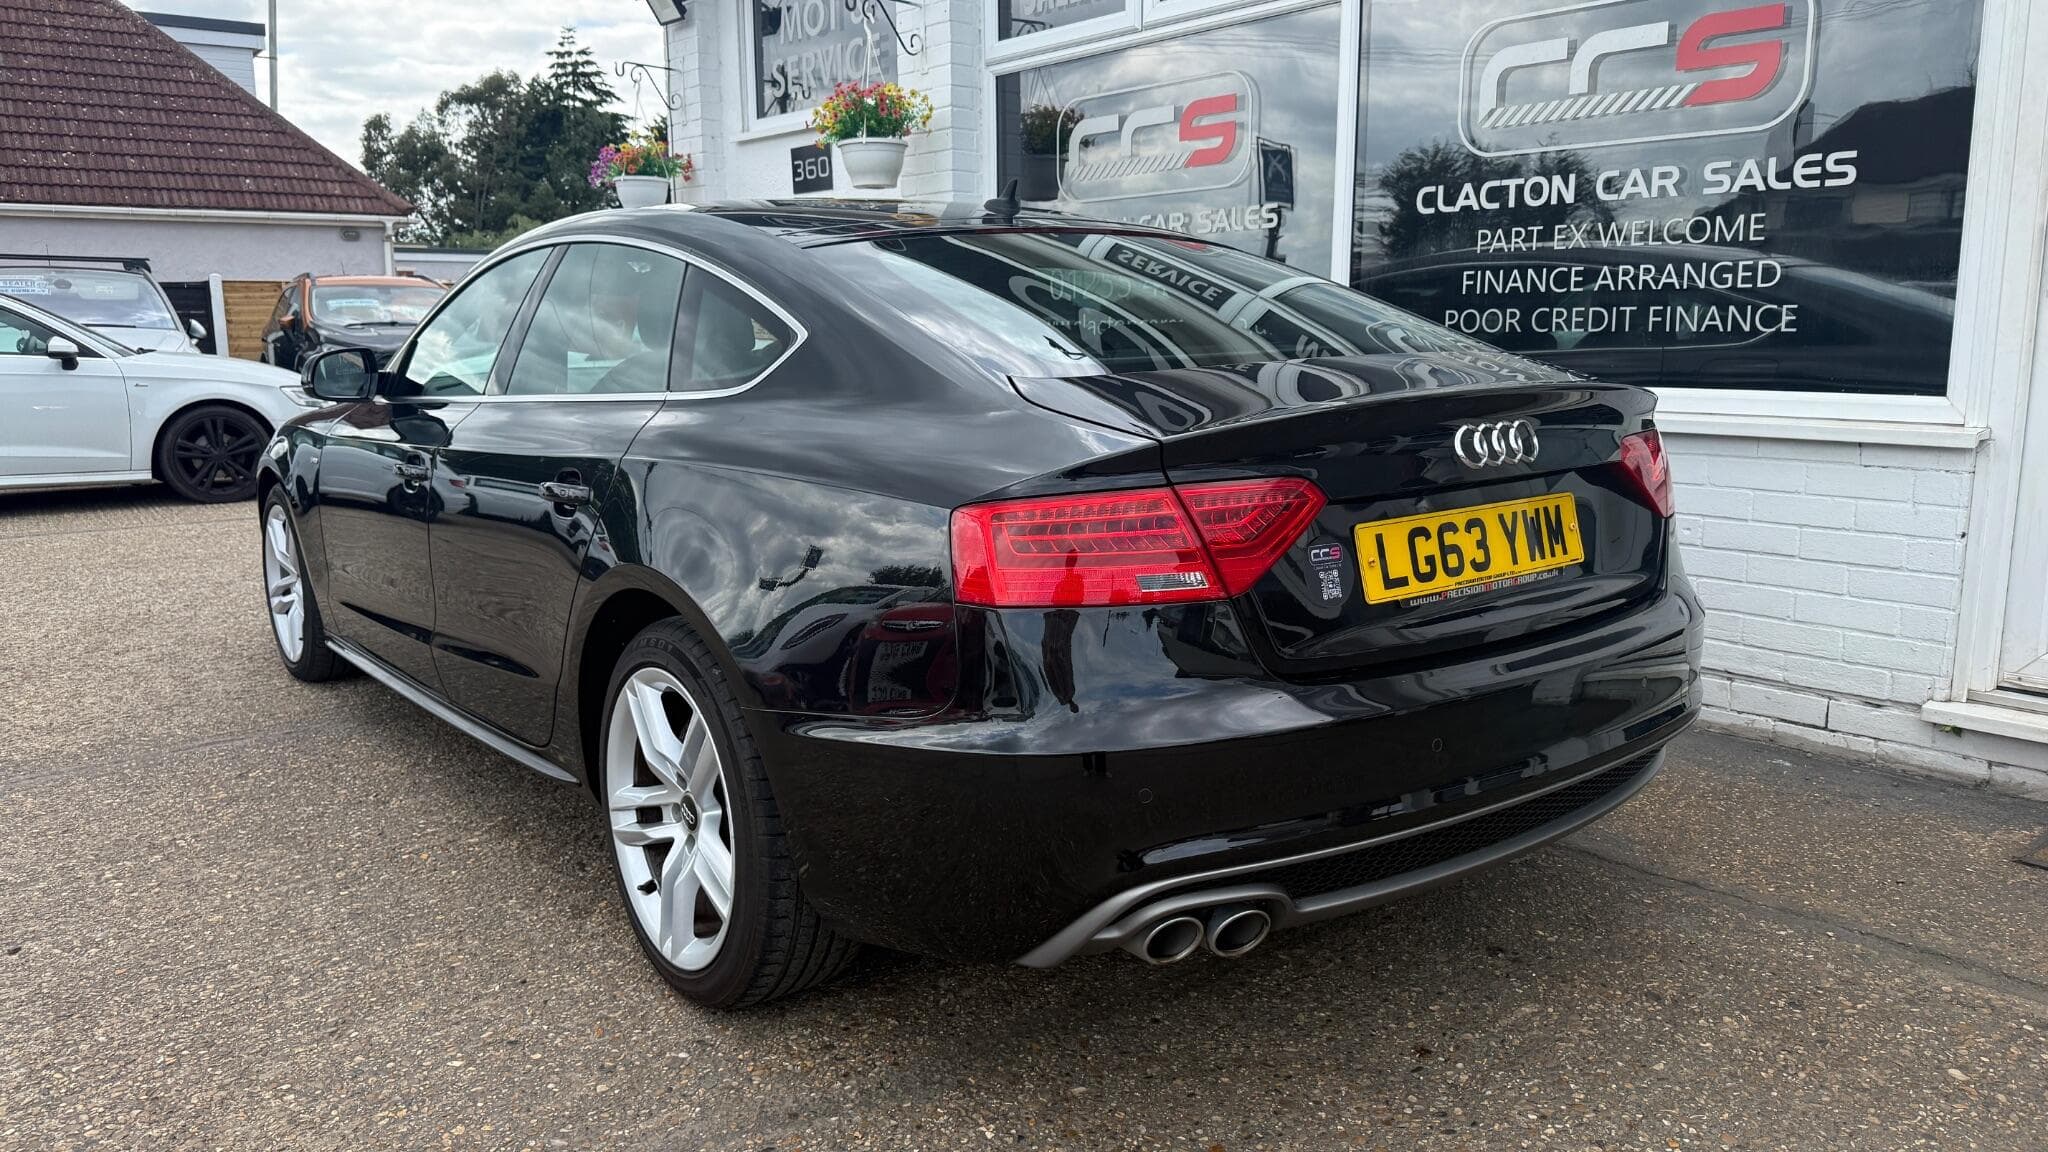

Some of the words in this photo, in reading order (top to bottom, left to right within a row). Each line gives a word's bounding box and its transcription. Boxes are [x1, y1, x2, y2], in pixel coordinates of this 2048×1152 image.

[772, 32, 881, 98] SERVICE
[794, 156, 830, 183] 360
[1416, 173, 1575, 215] CLACTON
[1595, 164, 1679, 200] CAR
[1703, 150, 1858, 194] SALES
[1197, 202, 1279, 234] SALES
[1476, 225, 1543, 254] PART
[1554, 223, 1587, 250] EX
[1598, 212, 1766, 247] WELCOME
[1461, 265, 1584, 295] FINANCE
[1594, 260, 1782, 292] ARRANGED
[1444, 308, 1521, 334] POOR
[1531, 305, 1637, 334] CREDIT
[1648, 303, 1798, 333] FINANCE
[1375, 518, 1492, 590] LG63
[1498, 504, 1568, 566] YWM
